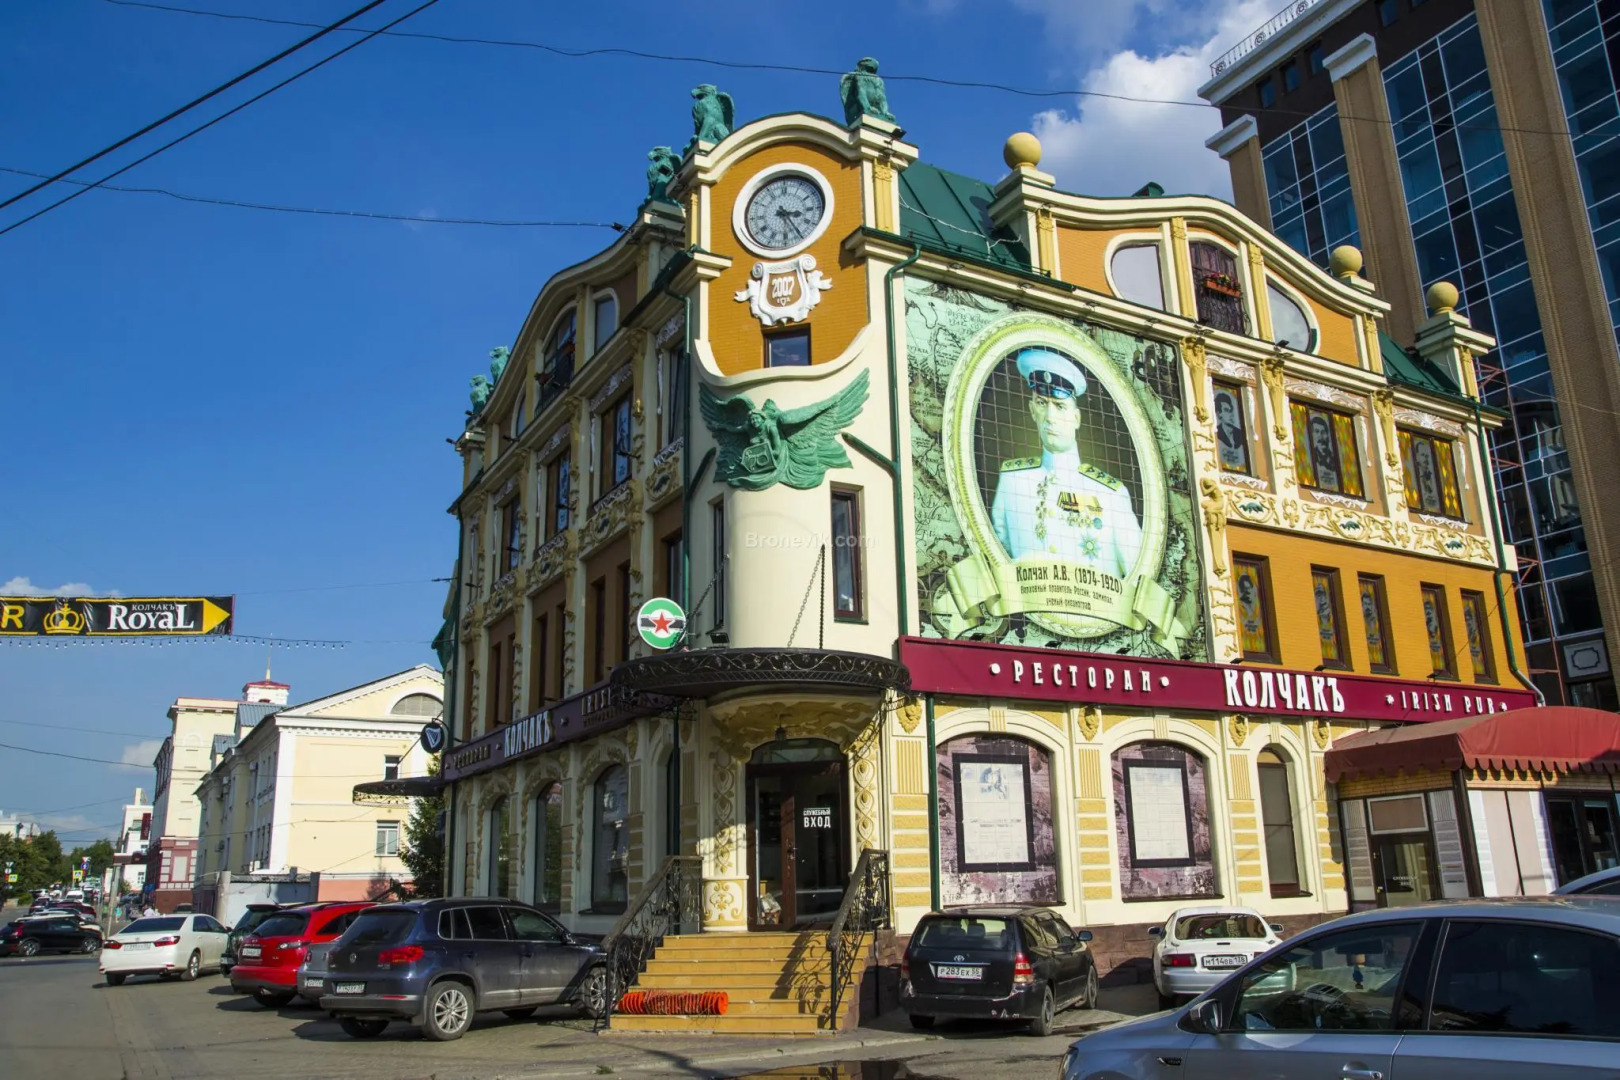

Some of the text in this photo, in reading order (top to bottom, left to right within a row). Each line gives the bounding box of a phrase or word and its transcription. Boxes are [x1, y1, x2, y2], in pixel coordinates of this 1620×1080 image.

[772, 276, 795, 298] 2007
[1016, 564, 1123, 595] Колчак А.В. (1874-1920)
[1013, 660, 1151, 692] РЕСТОРАН
[1223, 669, 1345, 712] КОЛЧАКЪ
[1401, 690, 1495, 715] IRISH PUB
[504, 711, 550, 759] КОЛЧАКЪ
[803, 816, 831, 828] ВХОД
